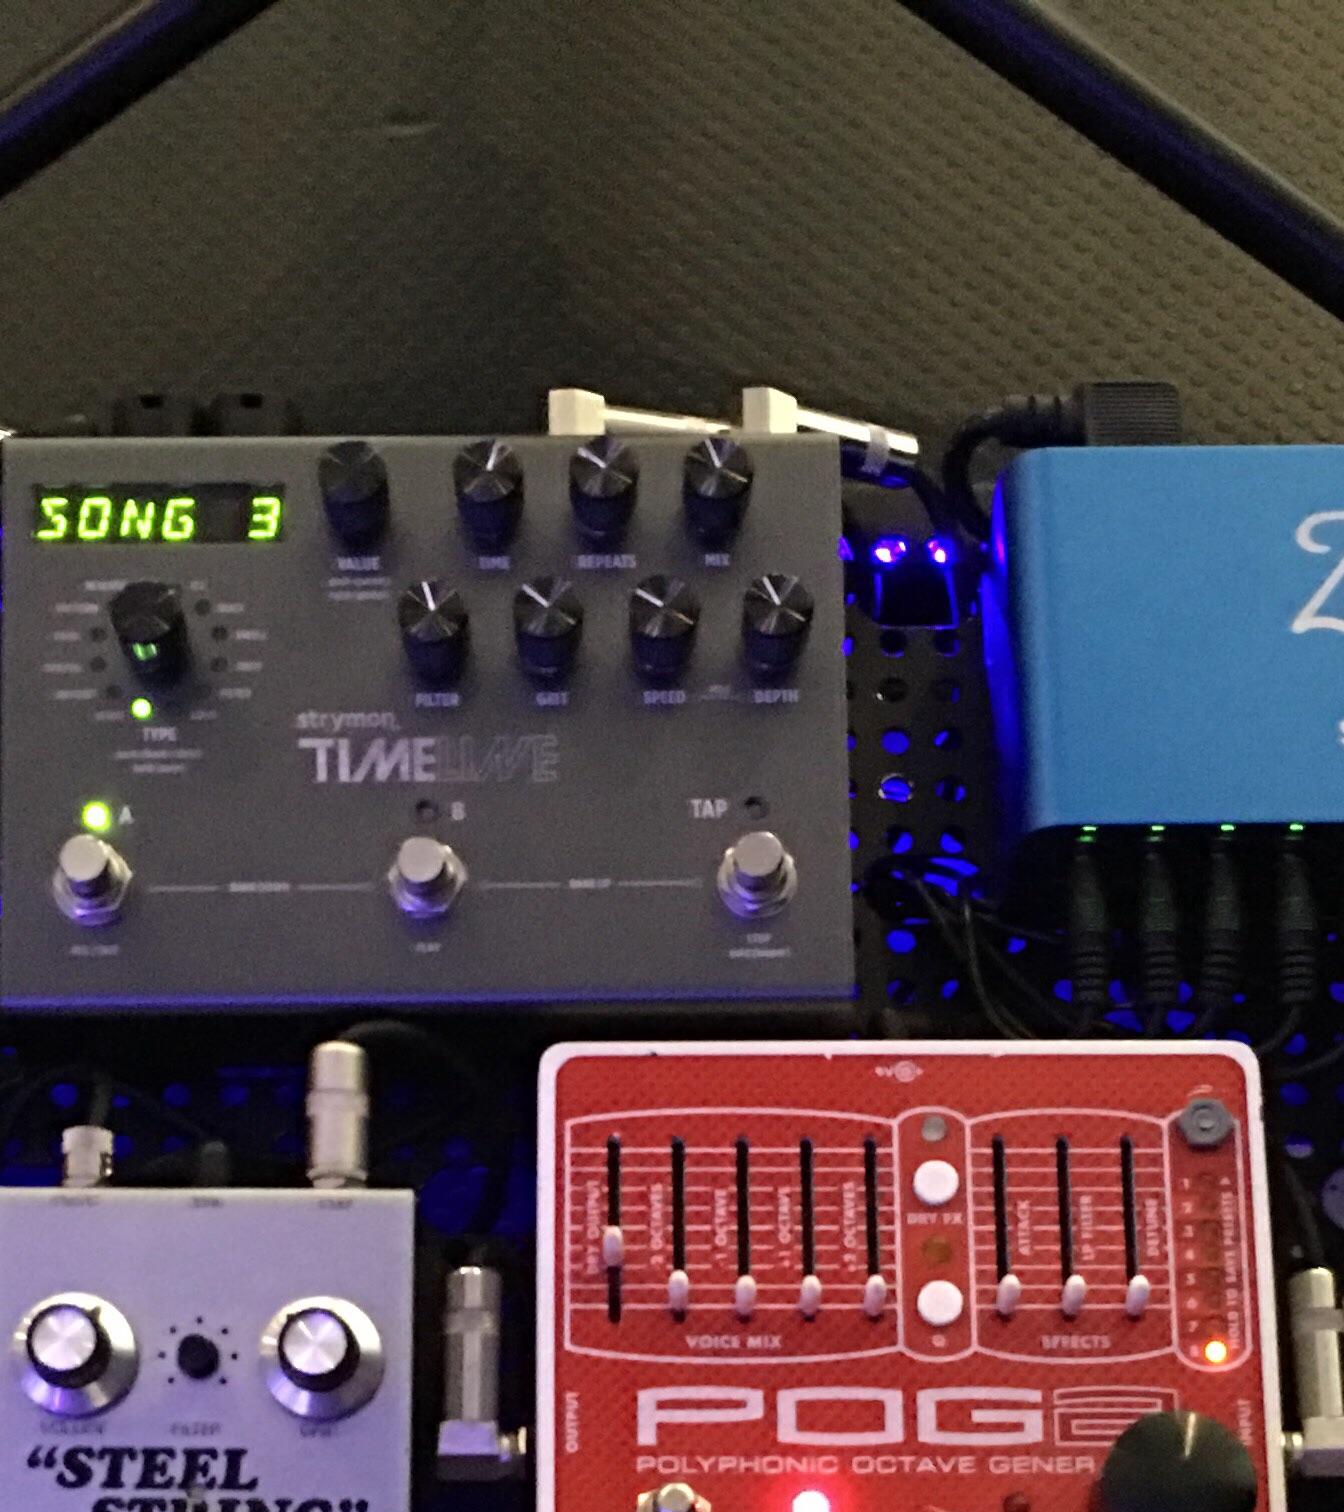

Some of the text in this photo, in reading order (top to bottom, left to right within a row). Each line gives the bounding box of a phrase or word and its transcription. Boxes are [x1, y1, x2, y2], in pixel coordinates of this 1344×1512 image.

[36, 497, 282, 540] SONG 3
[296, 711, 397, 732] strymon
[690, 798, 728, 818] TAP
[649, 1183, 665, 1251] OCTAVES
[713, 1188, 728, 1247] OCTAVE
[842, 1181, 857, 1249] OCTAVES
[1017, 1199, 1032, 1256] ATTACK
[686, 1335, 782, 1349] VOICE MIX
[564, 1390, 580, 1454] OUTPUT
[635, 1455, 1096, 1474] POLYPHONIC OCTAVE GENER
